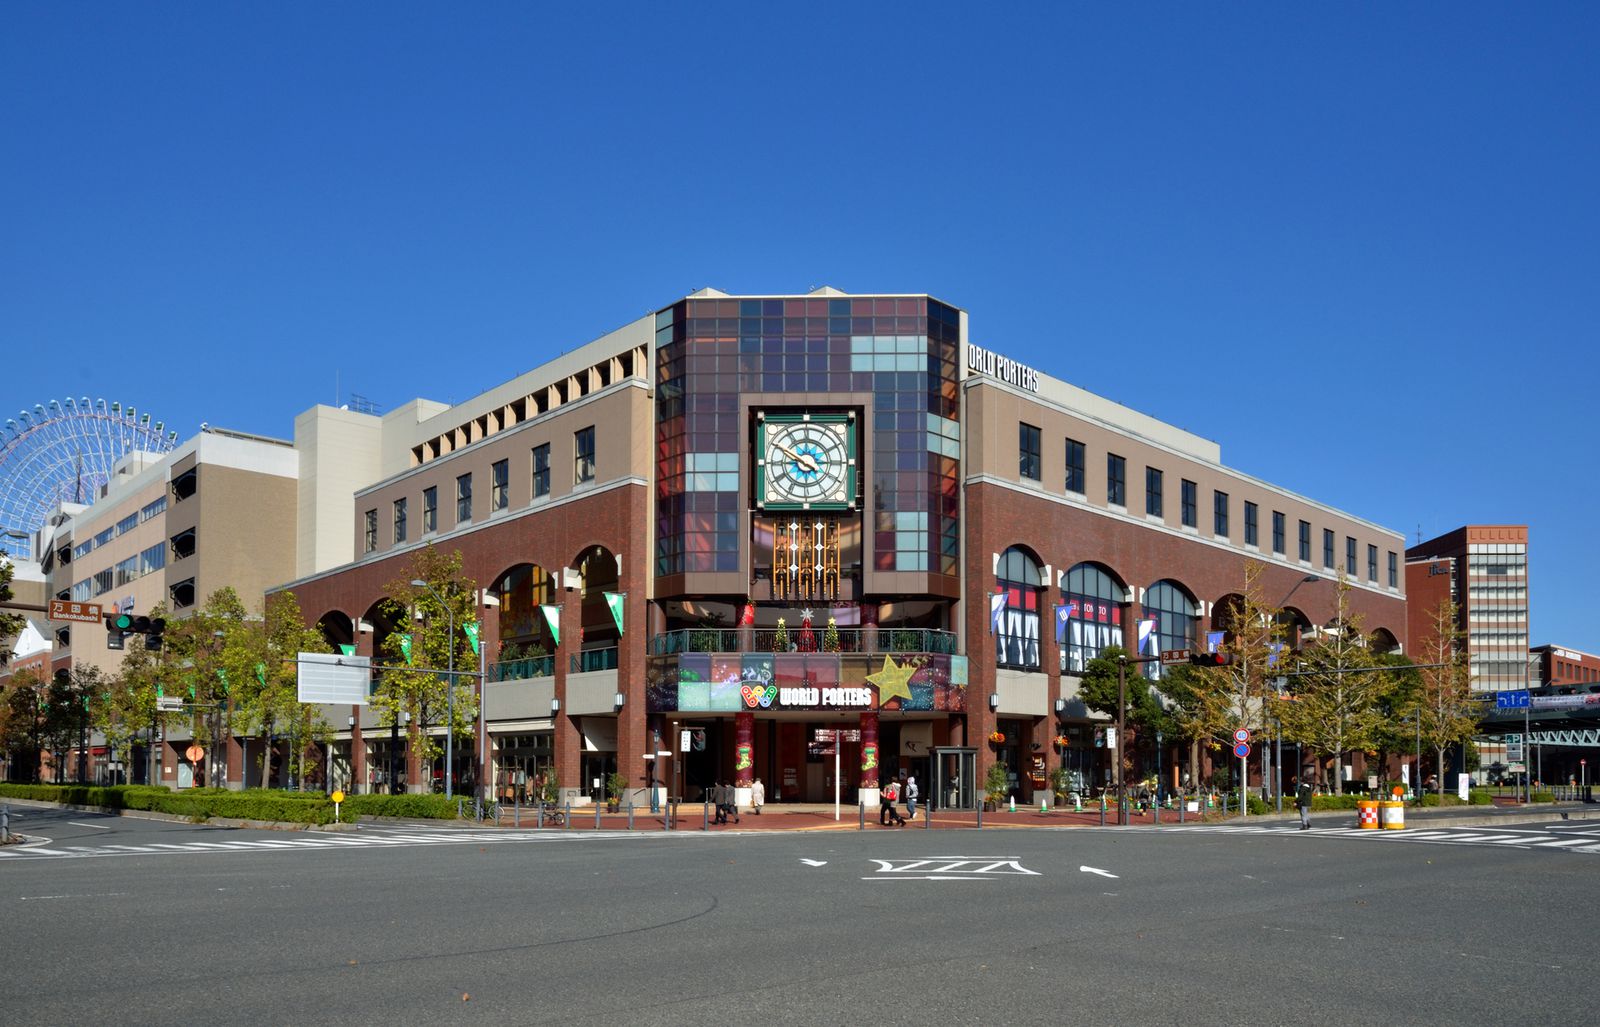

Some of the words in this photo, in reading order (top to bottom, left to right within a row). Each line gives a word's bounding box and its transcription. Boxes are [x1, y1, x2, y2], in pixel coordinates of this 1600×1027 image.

[969, 344, 993, 375] ORLD
[996, 354, 1039, 393] PORTERS
[780, 687, 819, 706] WORLD
[822, 687, 872, 706] PORTERS
